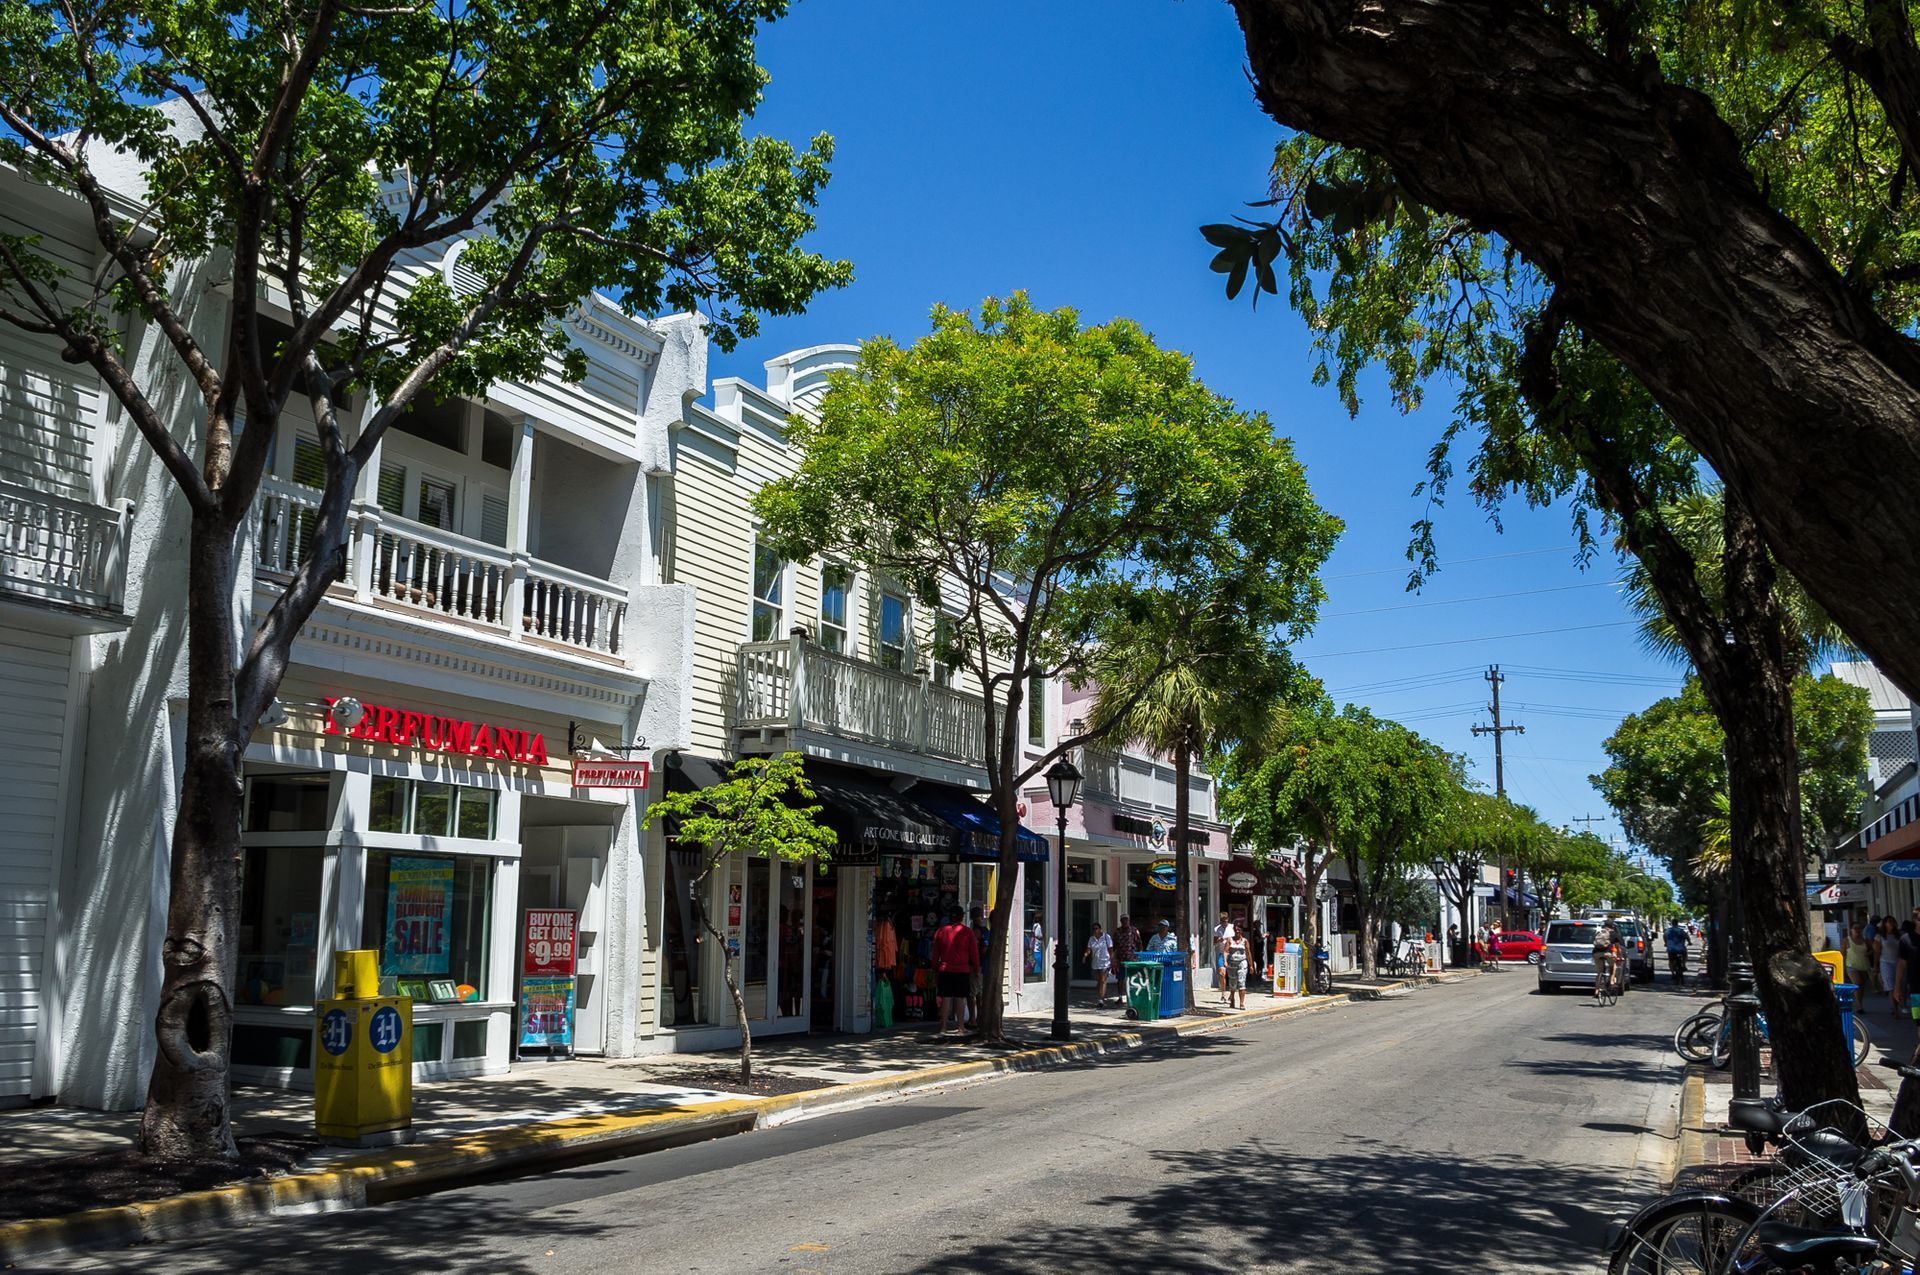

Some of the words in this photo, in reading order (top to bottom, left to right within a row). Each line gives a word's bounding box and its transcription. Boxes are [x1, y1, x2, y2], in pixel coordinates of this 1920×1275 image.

[323, 697, 549, 766] PERFUMANIA
[579, 769, 641, 780] PERFUMANIA
[863, 826, 879, 838] ART
[879, 828, 899, 841] GONE
[900, 831, 915, 843] WILD
[916, 833, 951, 847] GALLERIES
[396, 902, 444, 918] BLOWOUT
[529, 913, 552, 926] BUY
[552, 913, 574, 927] ONE
[394, 919, 443, 955] SALE
[529, 926, 550, 940] GET
[551, 927, 573, 940] ONE
[528, 941, 572, 966] $9.99
[376, 1013, 397, 1046] H
[528, 1014, 567, 1035] SALE
